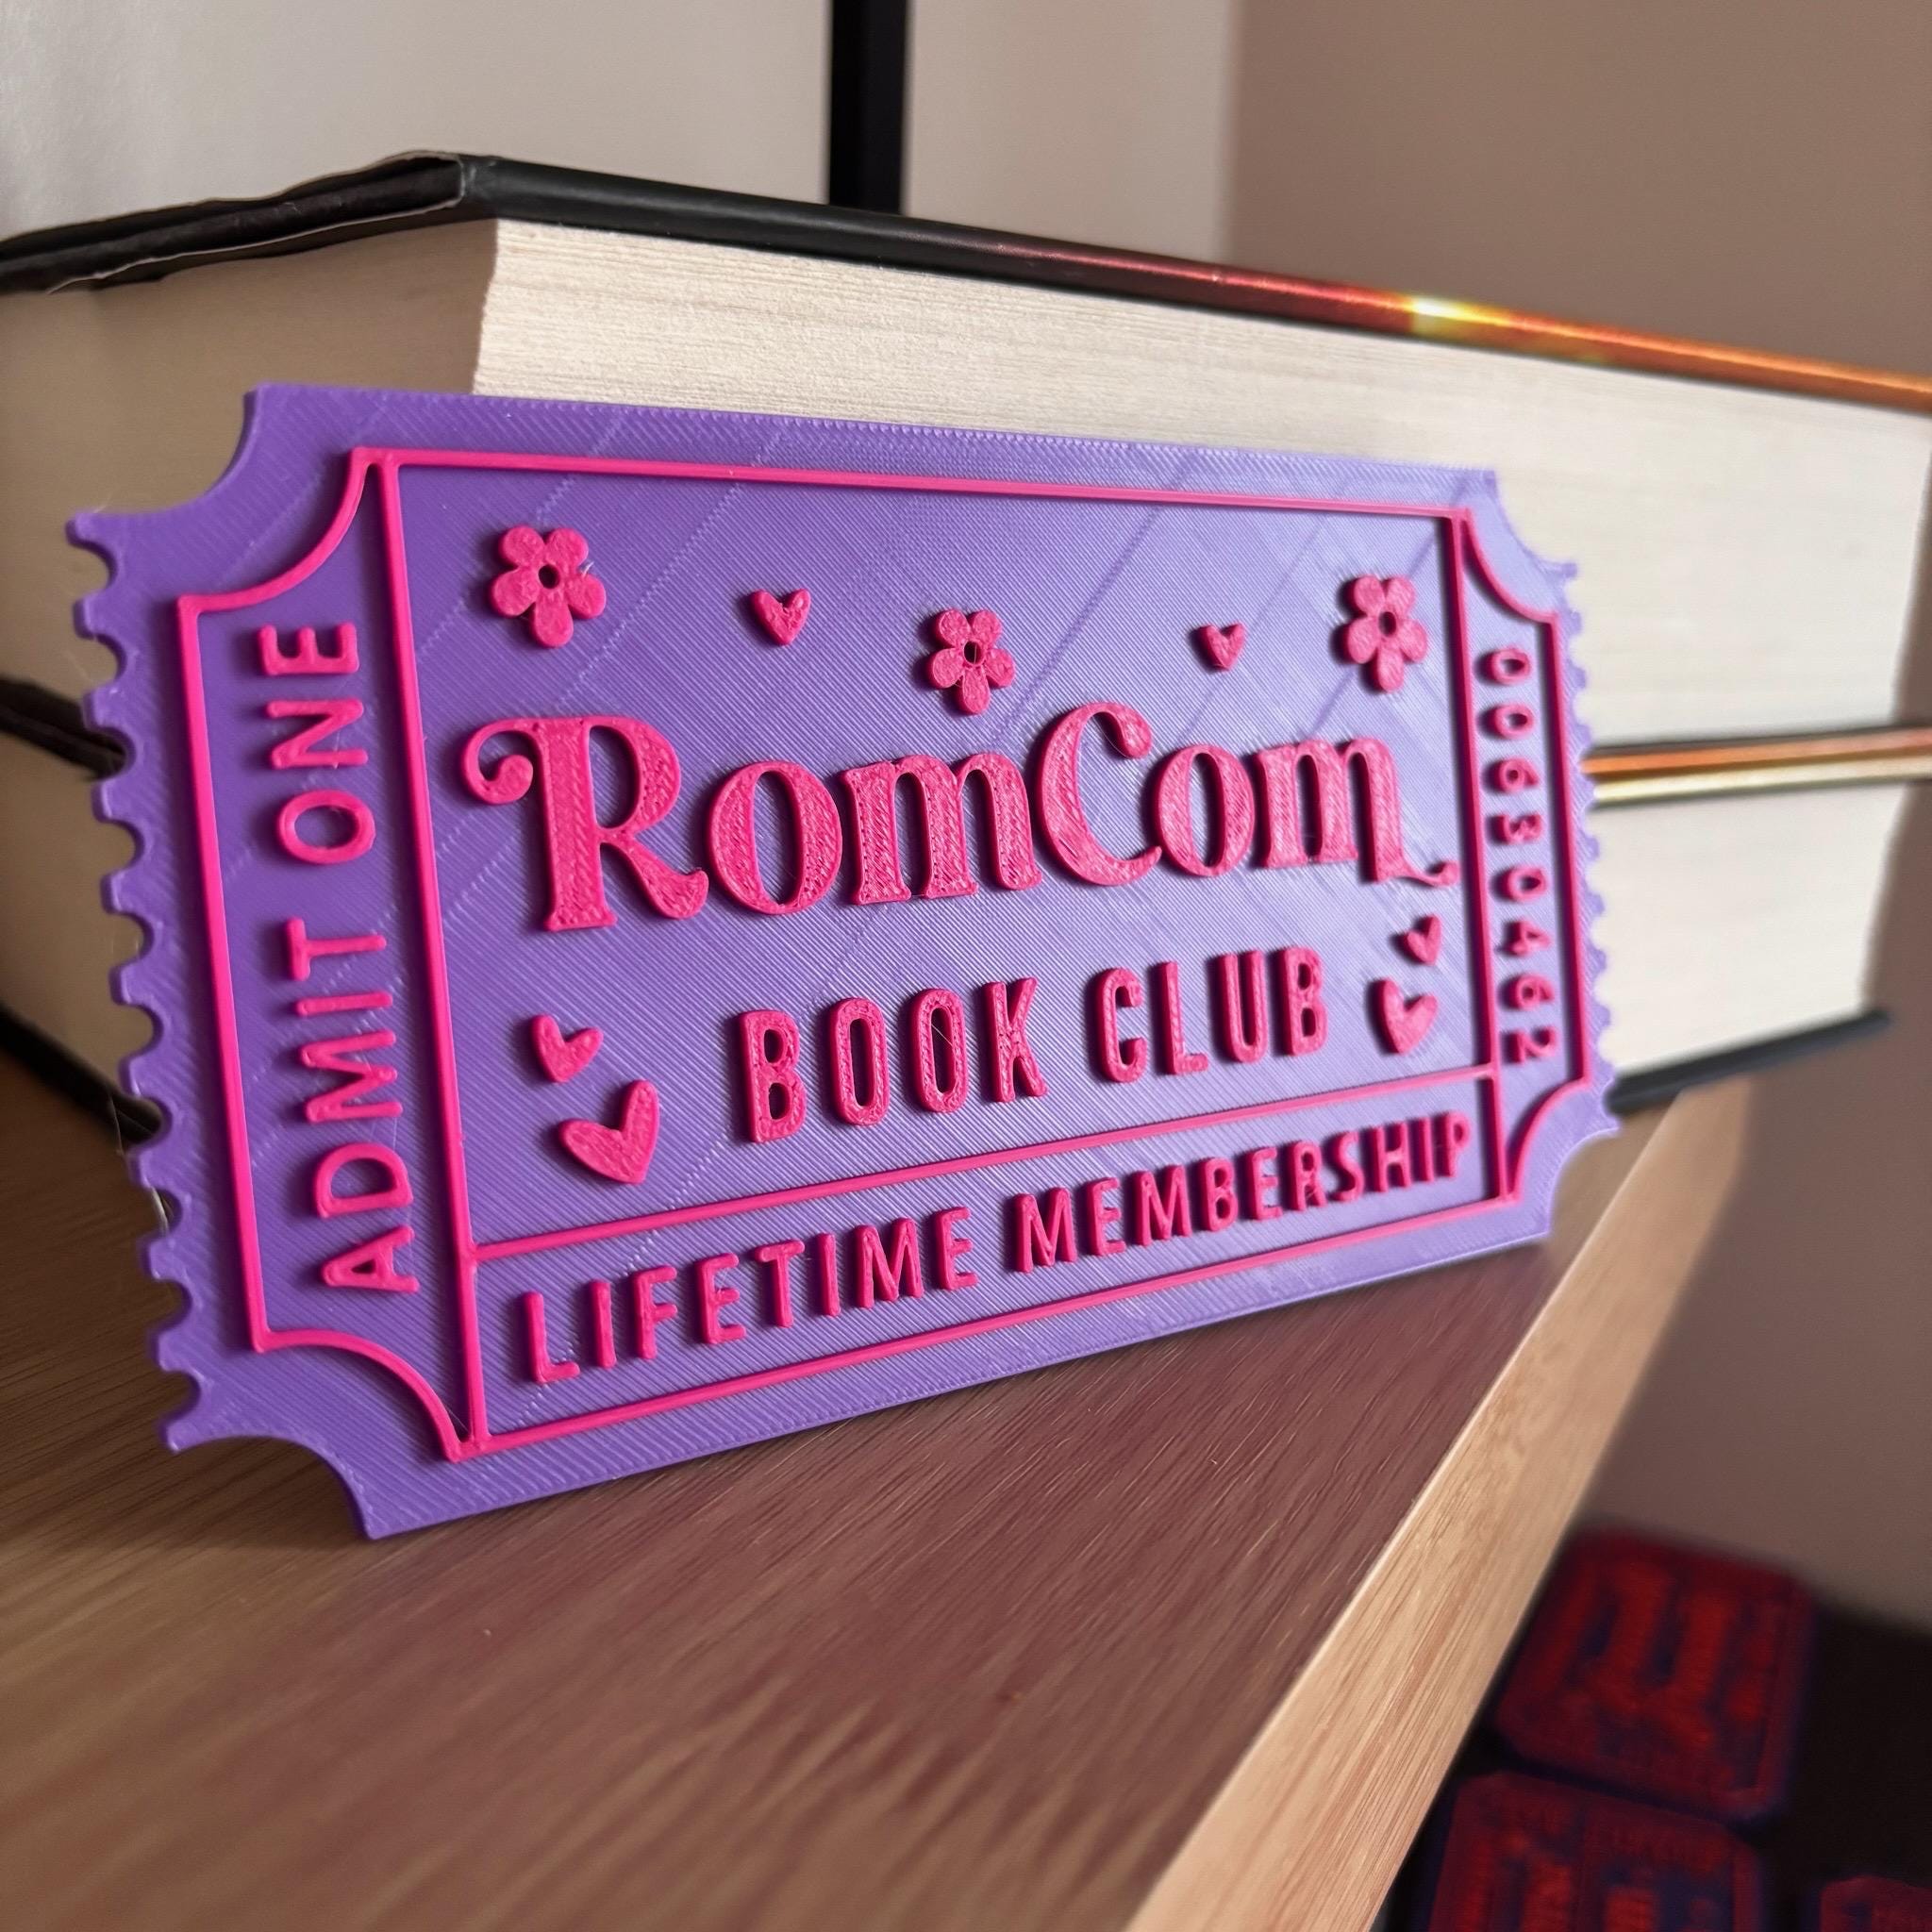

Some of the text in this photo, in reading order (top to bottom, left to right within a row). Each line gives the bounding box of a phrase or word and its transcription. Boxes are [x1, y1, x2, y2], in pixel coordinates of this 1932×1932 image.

[460, 702, 1458, 932] RomCom
[1485, 647, 1558, 1064] 00630462
[259, 623, 419, 1292] ADMIT ONE
[736, 946, 1327, 1142] BOOK CLUB
[525, 1112, 1472, 1384] LIFETIME MEMBERSHIP
